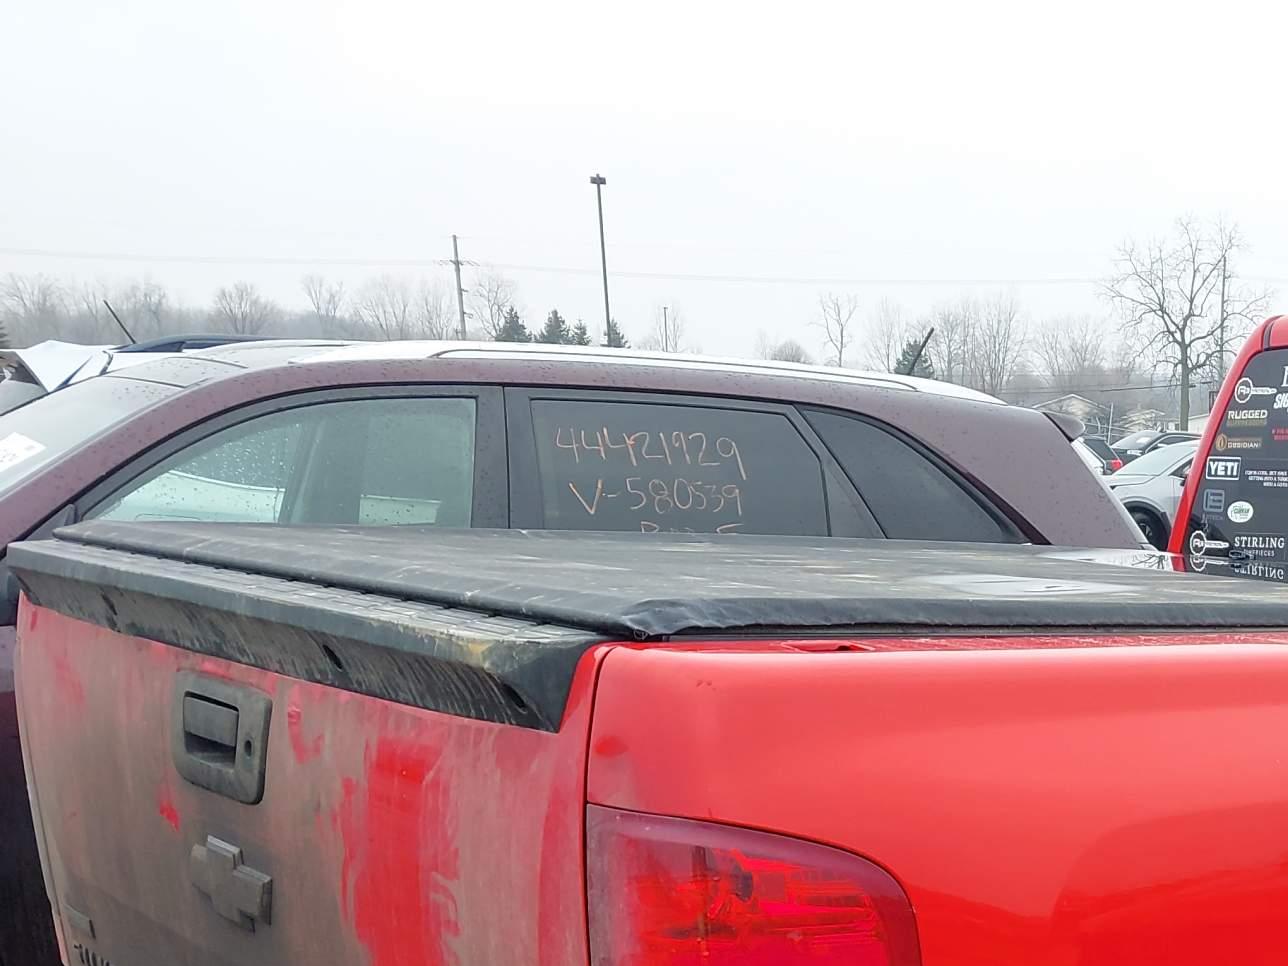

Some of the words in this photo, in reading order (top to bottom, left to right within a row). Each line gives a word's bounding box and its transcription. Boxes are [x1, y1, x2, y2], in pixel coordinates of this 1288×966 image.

[1228, 409, 1268, 420] RUGGED
[556, 427, 747, 480] 44421929
[1209, 461, 1239, 476] YETI
[1234, 536, 1285, 548] STIRLING
